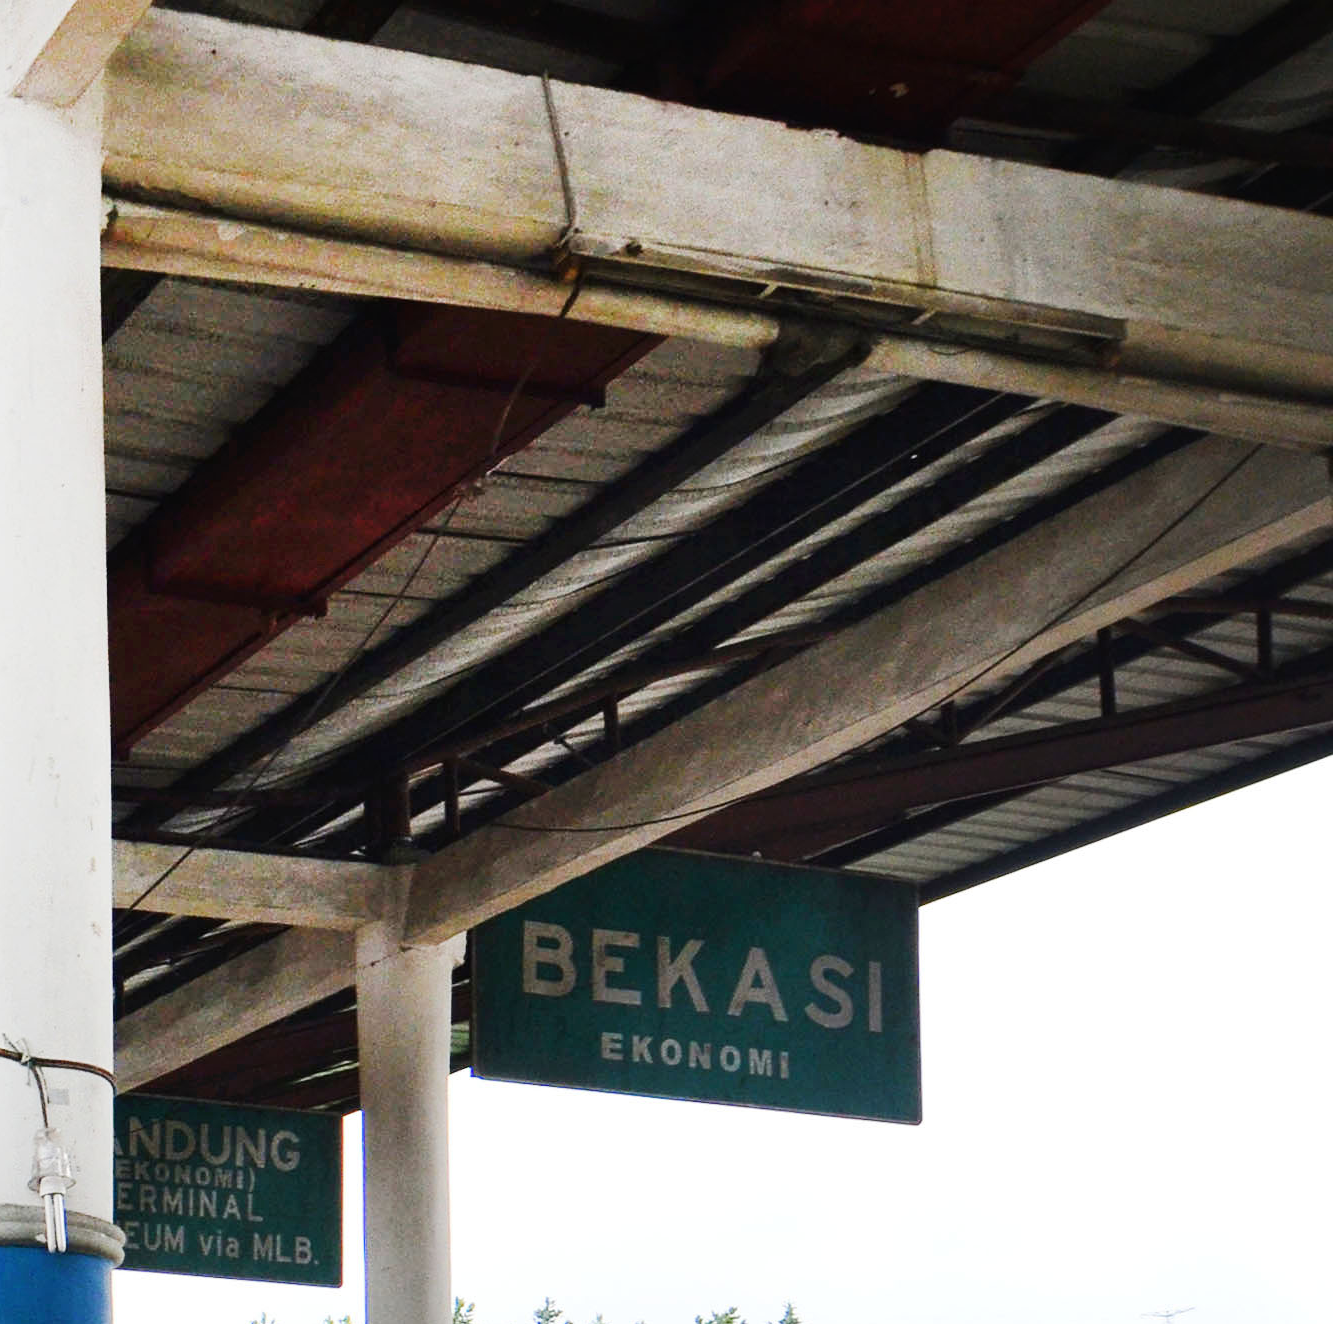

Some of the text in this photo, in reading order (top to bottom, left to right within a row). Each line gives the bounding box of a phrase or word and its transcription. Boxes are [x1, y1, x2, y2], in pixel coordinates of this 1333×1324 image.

[521, 919, 882, 1033] BEKASI
[600, 1031, 789, 1079] EKONOMI
[117, 1182, 263, 1222] ERMINAL
[199, 1230, 239, 1258] via
[253, 1232, 320, 1265] MLB.
